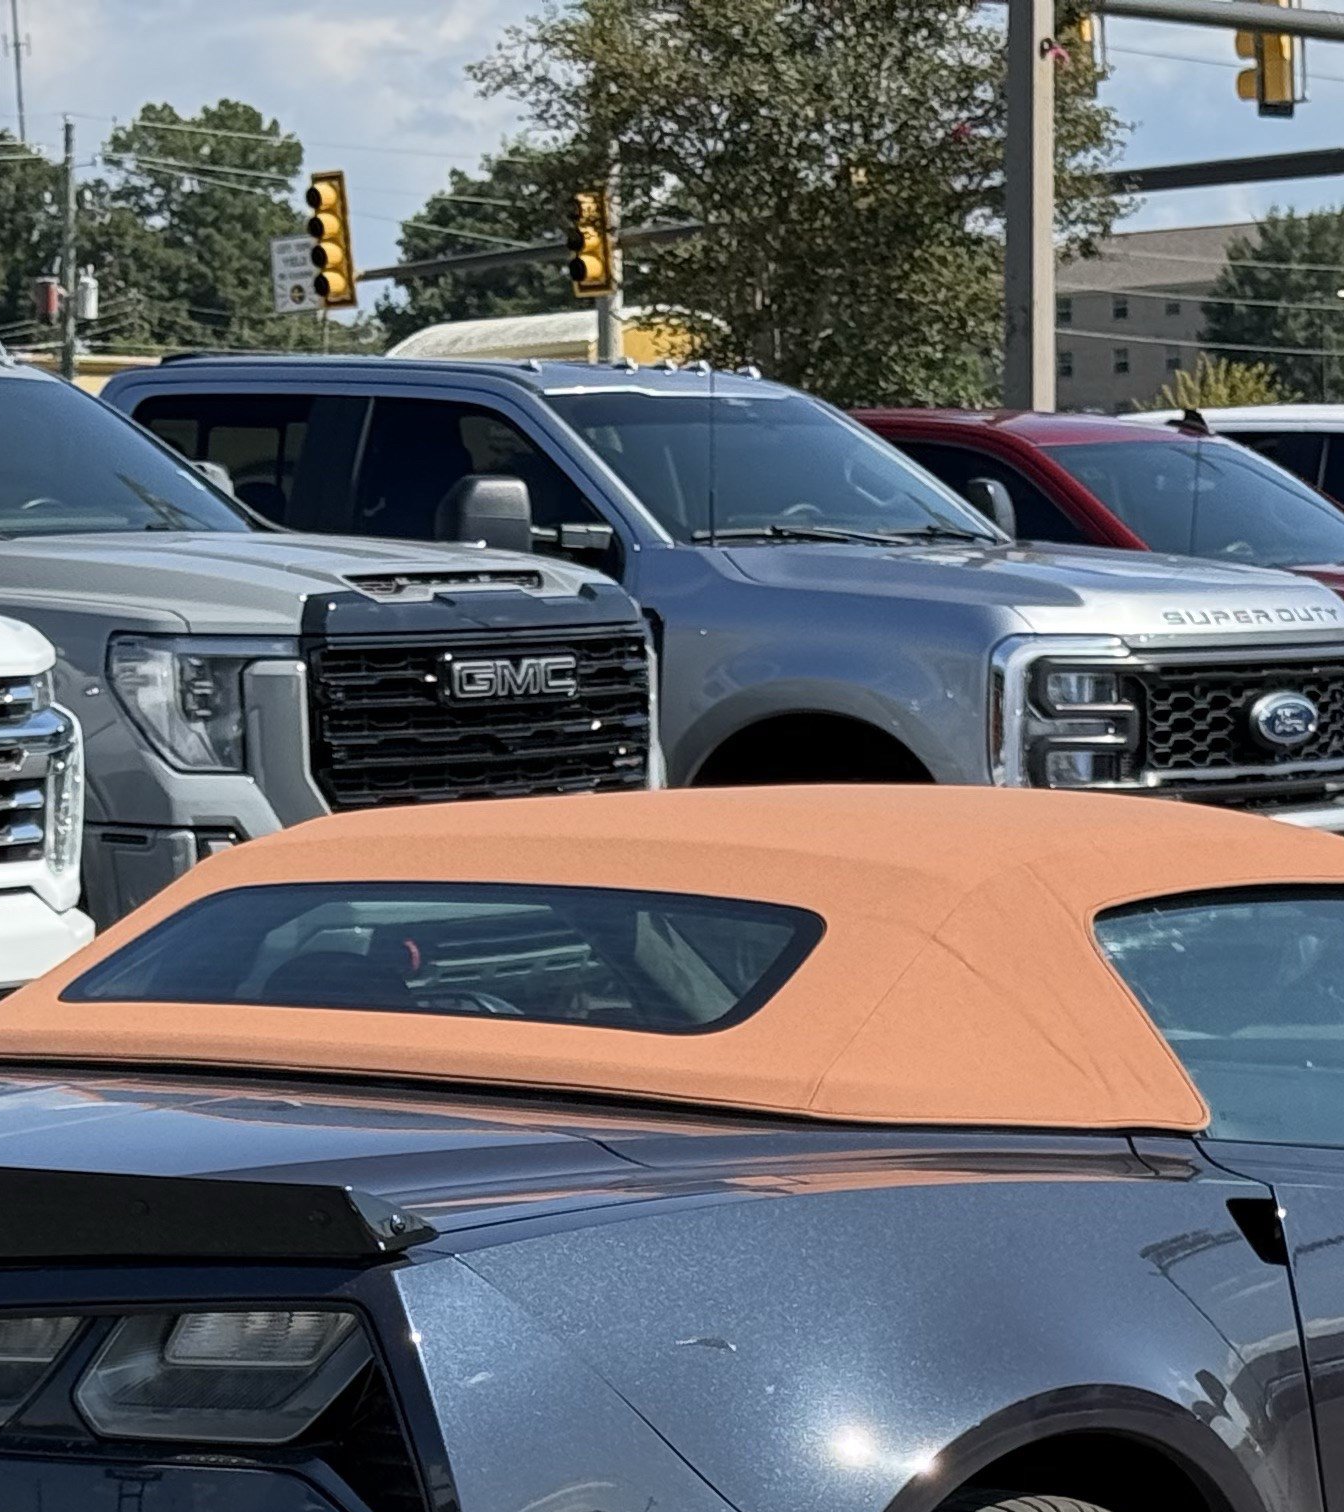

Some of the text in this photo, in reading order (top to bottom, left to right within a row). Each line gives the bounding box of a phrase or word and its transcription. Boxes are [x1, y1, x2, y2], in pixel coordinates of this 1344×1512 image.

[1162, 604, 1338, 626] SUPER DUTY
[452, 655, 577, 698] GMC
